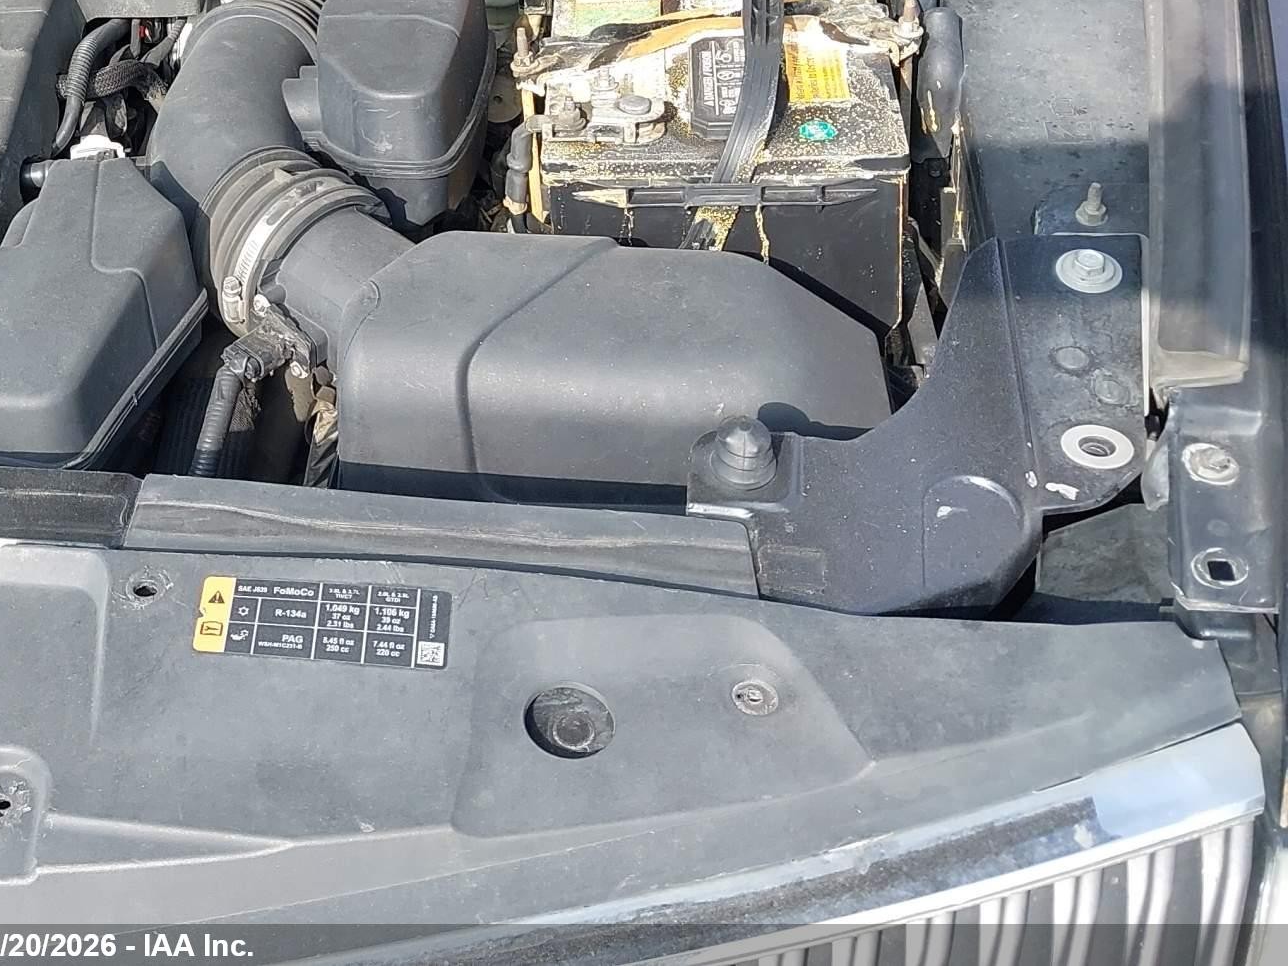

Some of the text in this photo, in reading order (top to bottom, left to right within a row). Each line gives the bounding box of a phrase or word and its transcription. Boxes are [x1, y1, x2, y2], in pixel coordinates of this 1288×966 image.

[273, 587, 315, 597] FoMoCo
[274, 608, 307, 619] R-134a
[325, 603, 360, 616] 1.049 kg
[374, 607, 410, 619] 1.106 kg
[343, 621, 354, 629] lbs
[391, 617, 401, 625] oz
[392, 625, 404, 633] lbs
[281, 634, 304, 643] PAG
[325, 644, 339, 652] 250
